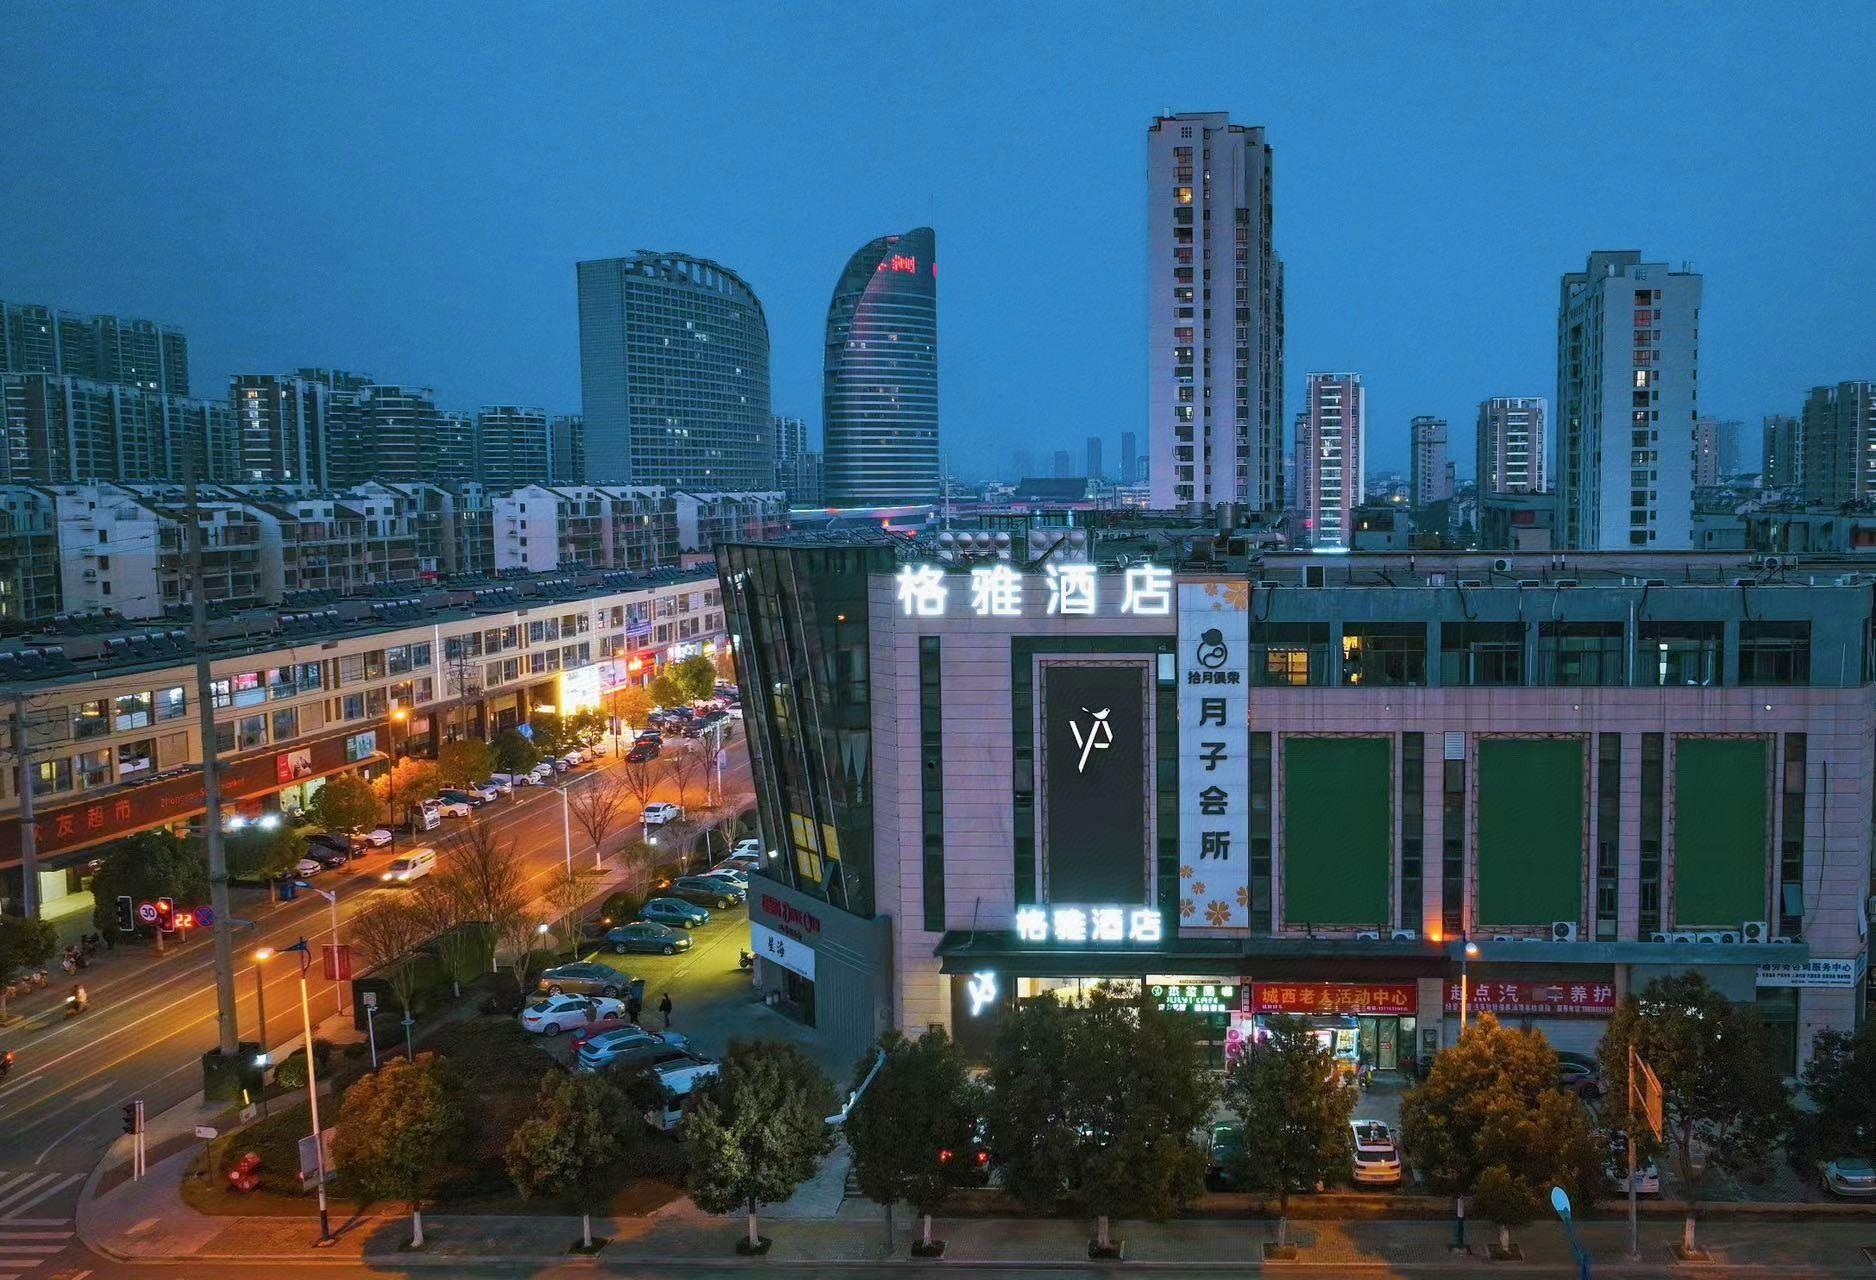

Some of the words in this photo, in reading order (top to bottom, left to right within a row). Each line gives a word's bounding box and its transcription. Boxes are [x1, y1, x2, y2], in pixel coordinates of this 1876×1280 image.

[1199, 697, 1230, 861] 月子会所
[141, 907, 156, 918] 30
[175, 914, 192, 927] 22
[1262, 988, 1408, 1005] 城西老人活动中心
